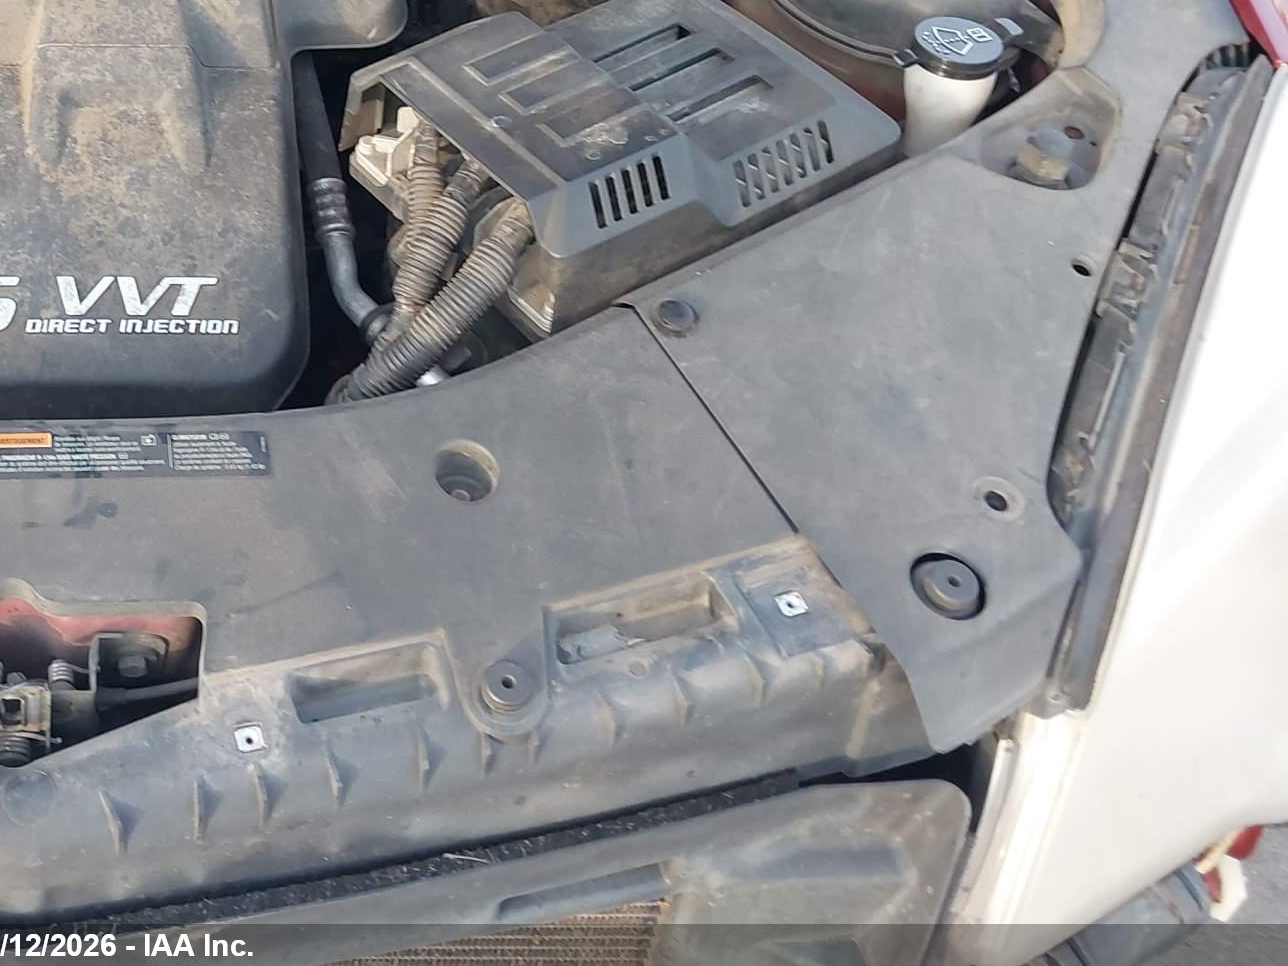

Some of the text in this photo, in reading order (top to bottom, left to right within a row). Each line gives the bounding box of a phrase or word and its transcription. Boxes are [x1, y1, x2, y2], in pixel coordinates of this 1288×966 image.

[56, 276, 218, 316] VVT
[25, 318, 240, 335] DIRECT INJECTION
